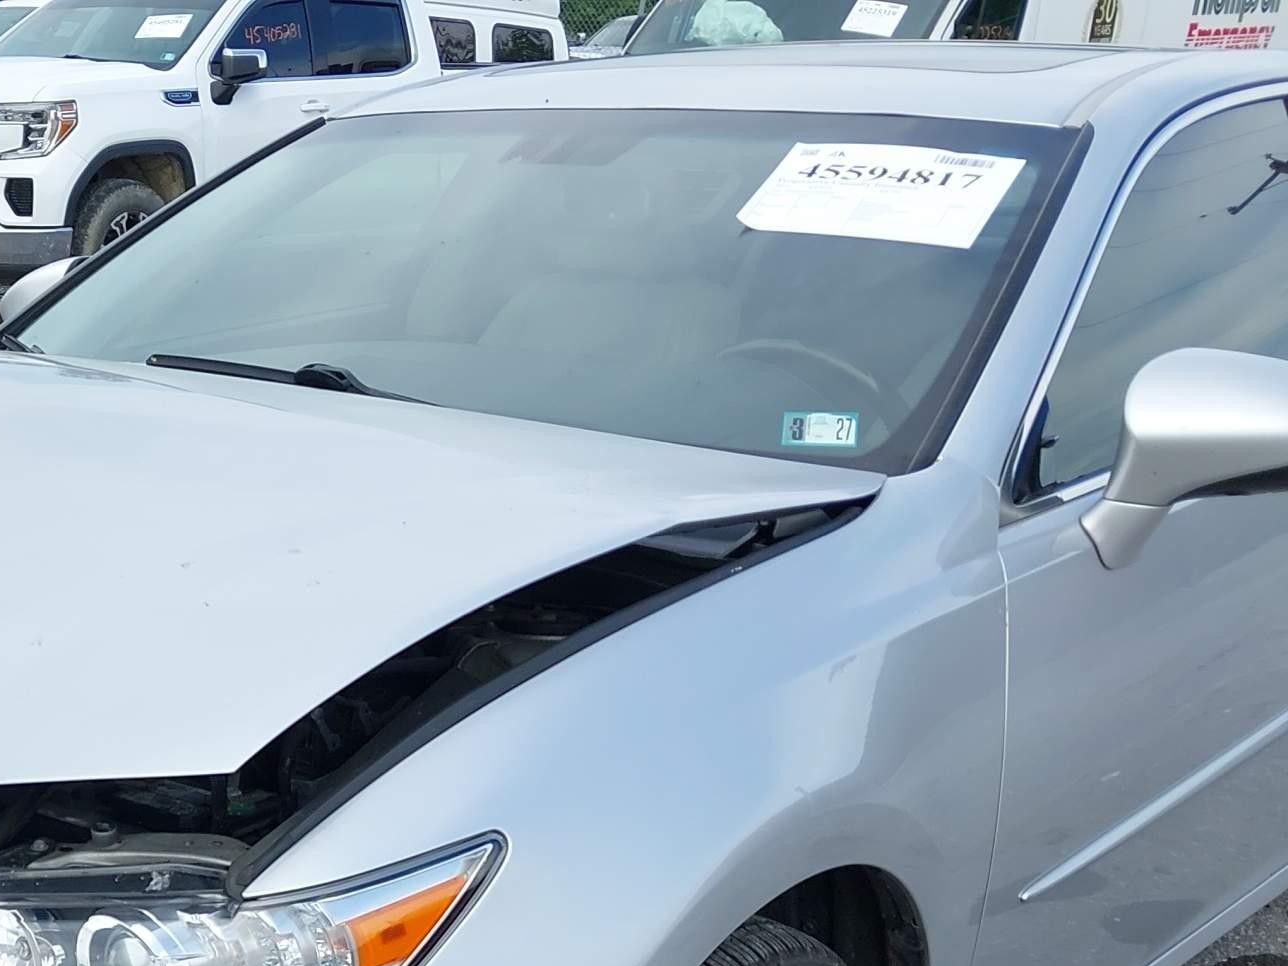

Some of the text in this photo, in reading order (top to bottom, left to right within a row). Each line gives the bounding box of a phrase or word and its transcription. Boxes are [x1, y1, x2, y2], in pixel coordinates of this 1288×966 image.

[1094, 24, 1112, 36] YEARS
[797, 162, 985, 189] 45594817
[791, 417, 853, 441] 3 27
